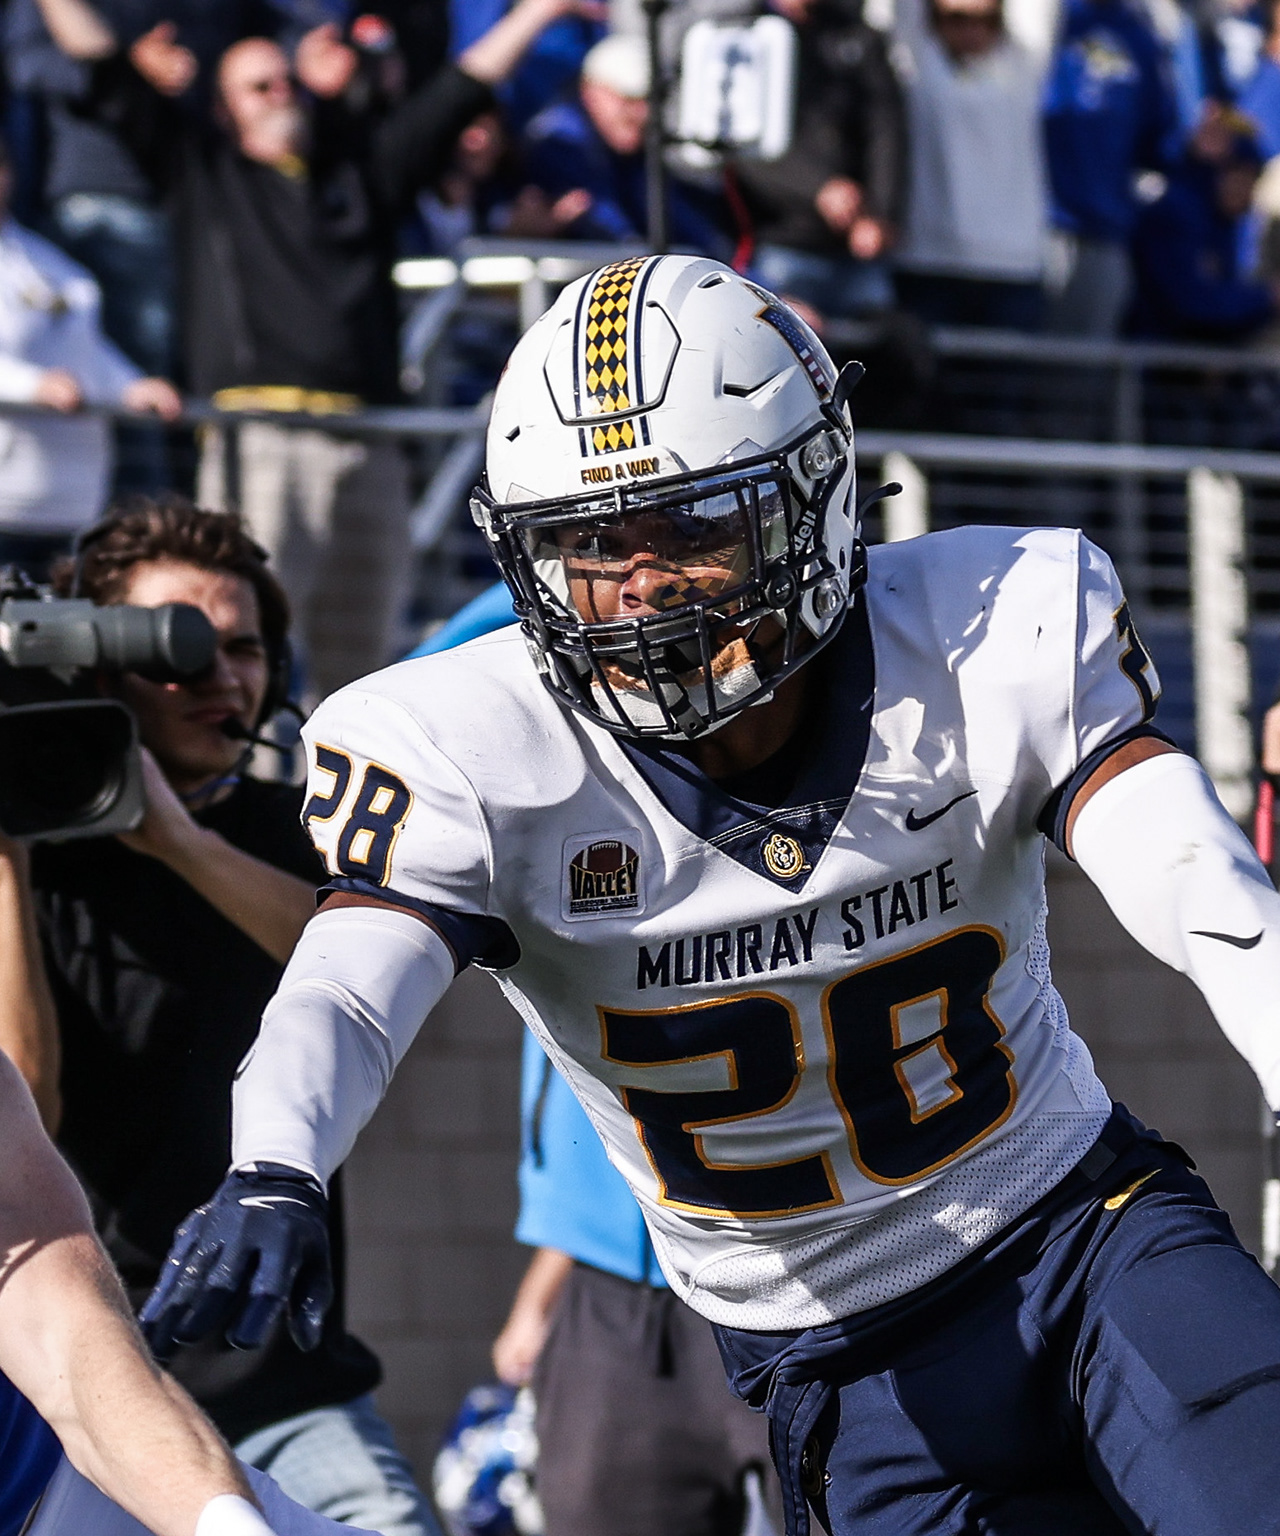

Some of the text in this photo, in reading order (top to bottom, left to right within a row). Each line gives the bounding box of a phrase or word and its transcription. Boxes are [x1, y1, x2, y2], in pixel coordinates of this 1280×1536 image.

[580, 456, 660, 485] FIND A WAY
[300, 742, 414, 888] 28
[569, 854, 640, 901] VALLEY
[636, 857, 960, 990] MURRAY STATE
[595, 922, 1019, 1219] 28
